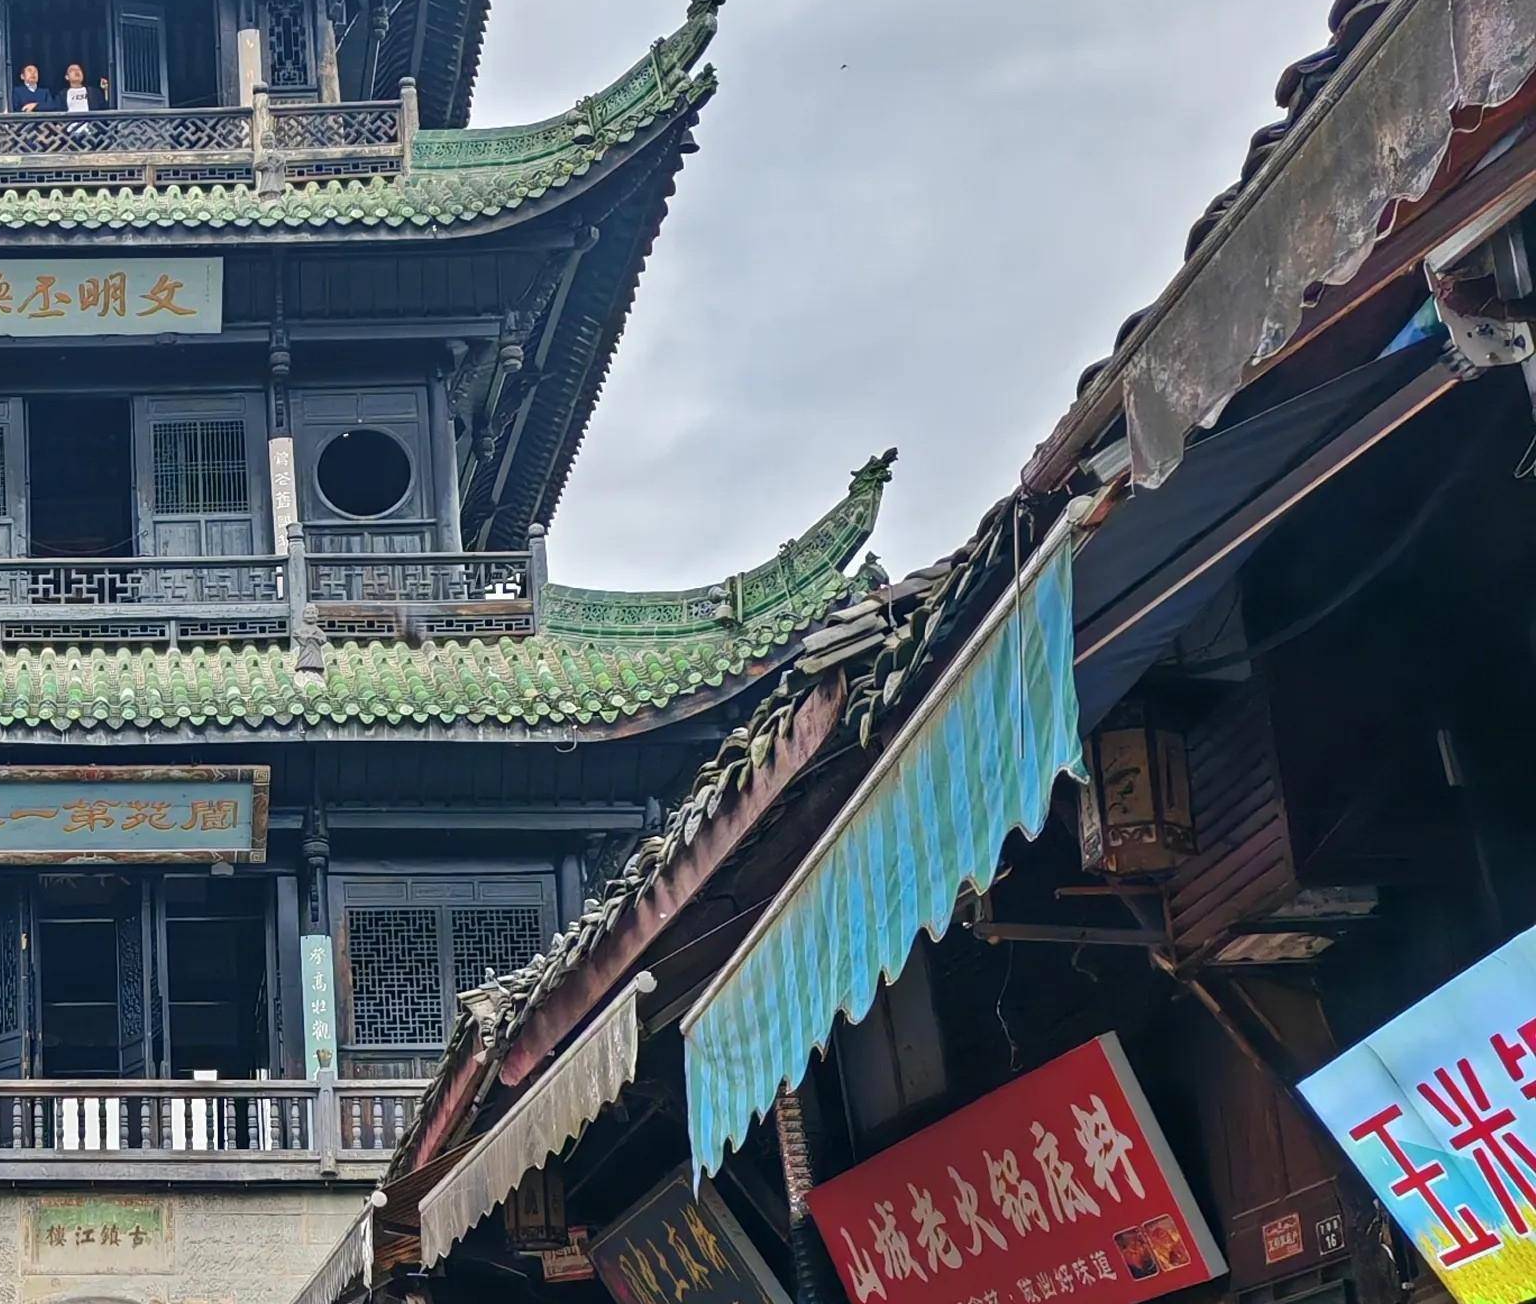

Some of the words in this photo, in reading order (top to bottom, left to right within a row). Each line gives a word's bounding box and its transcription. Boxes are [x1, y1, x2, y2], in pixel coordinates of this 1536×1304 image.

[840, 1094, 1146, 1304] 山城老火锅底料
